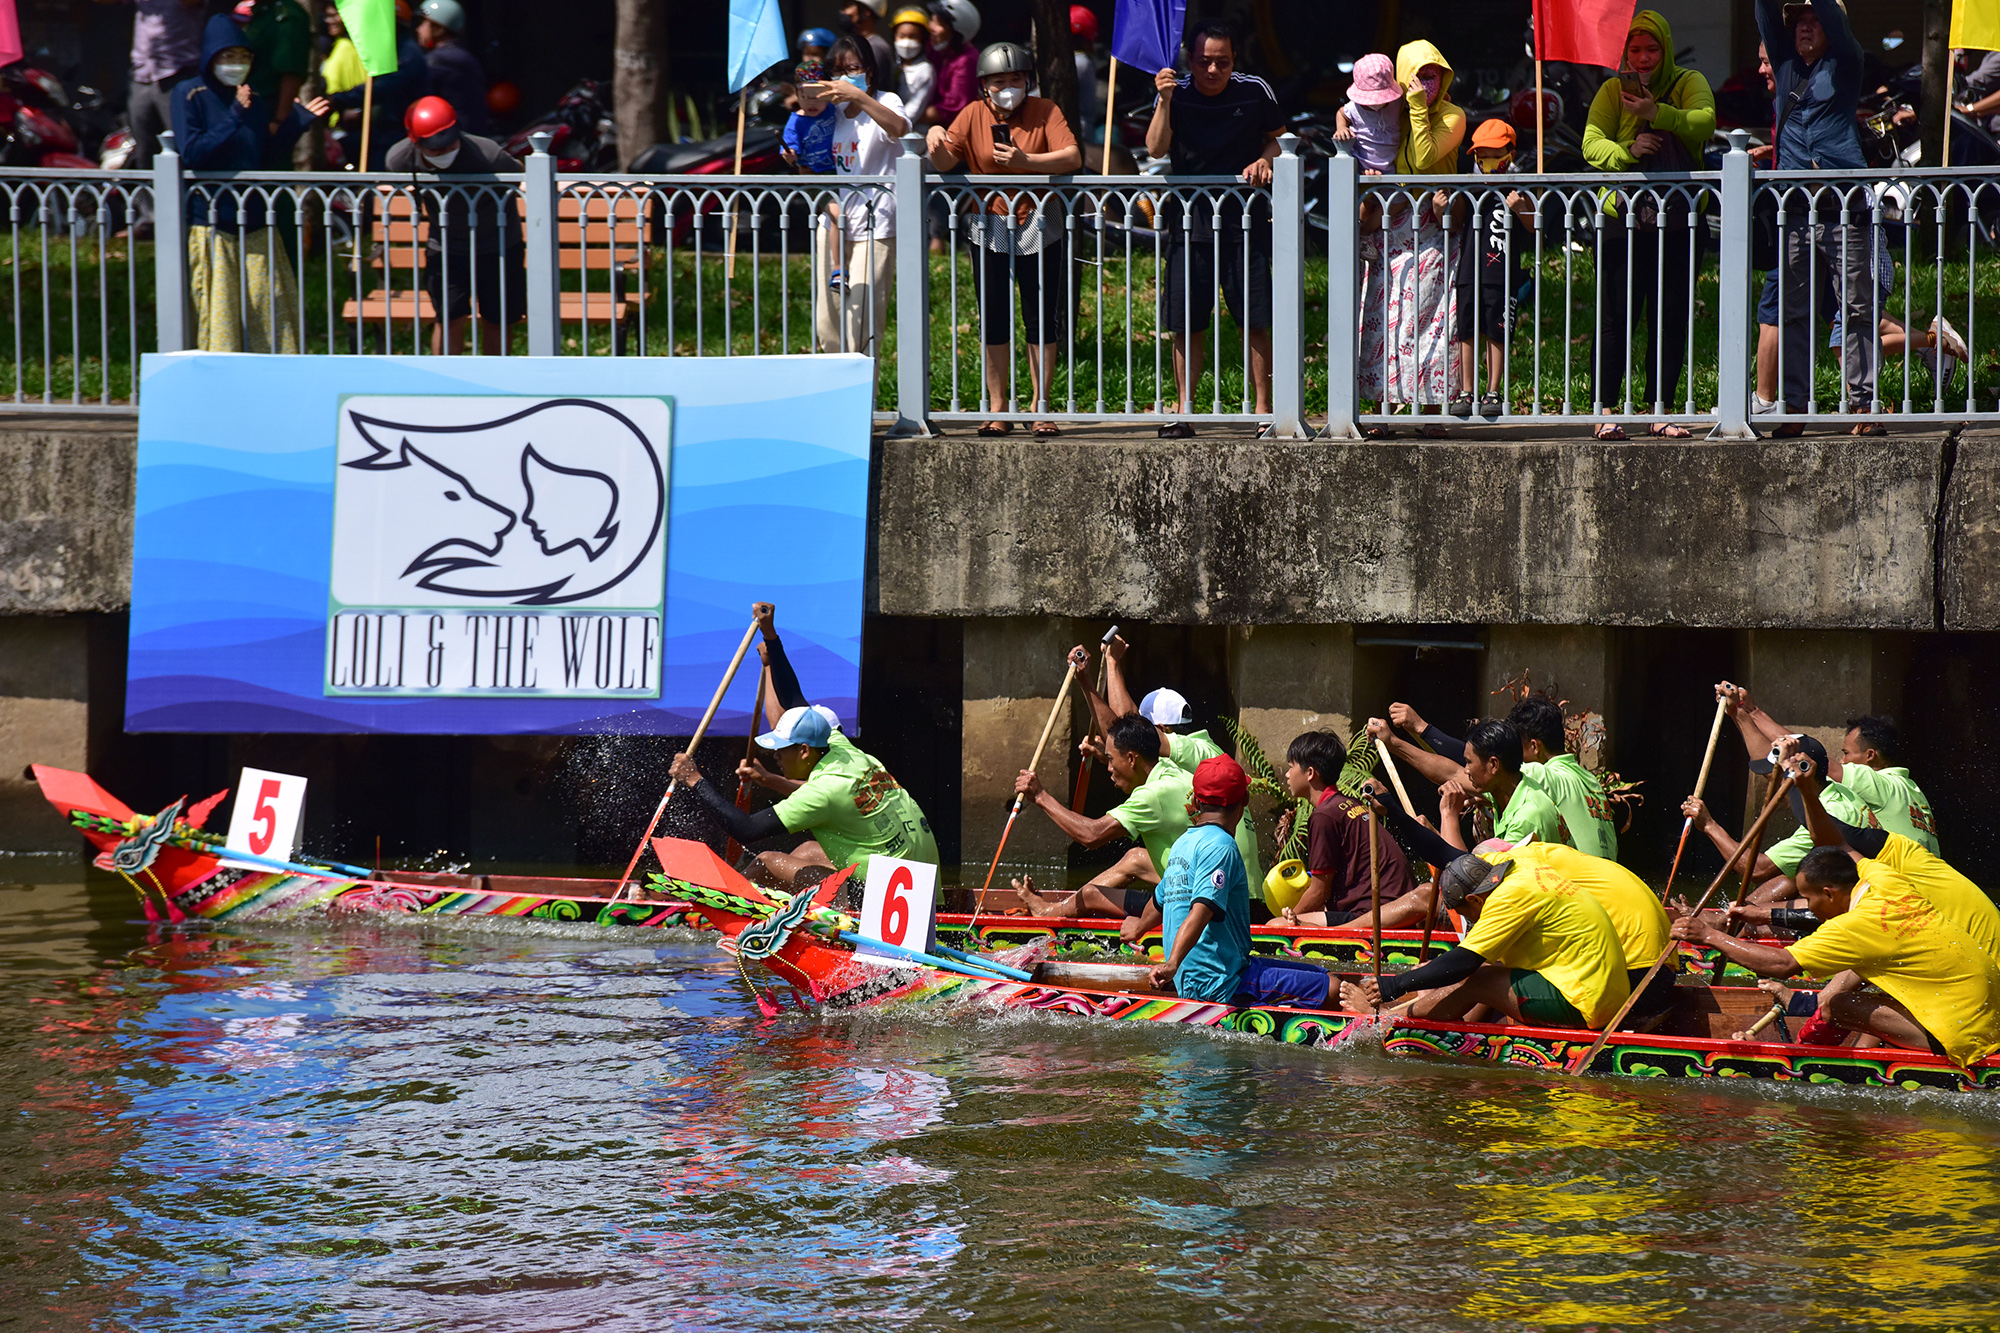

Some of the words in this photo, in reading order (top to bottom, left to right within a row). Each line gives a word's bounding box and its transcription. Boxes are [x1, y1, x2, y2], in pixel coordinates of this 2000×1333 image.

[331, 613, 409, 688] LOLI
[426, 613, 446, 689] &
[465, 614, 539, 689] THE
[557, 614, 660, 690] WOLF
[248, 778, 282, 856] 5
[881, 865, 913, 947] 6
